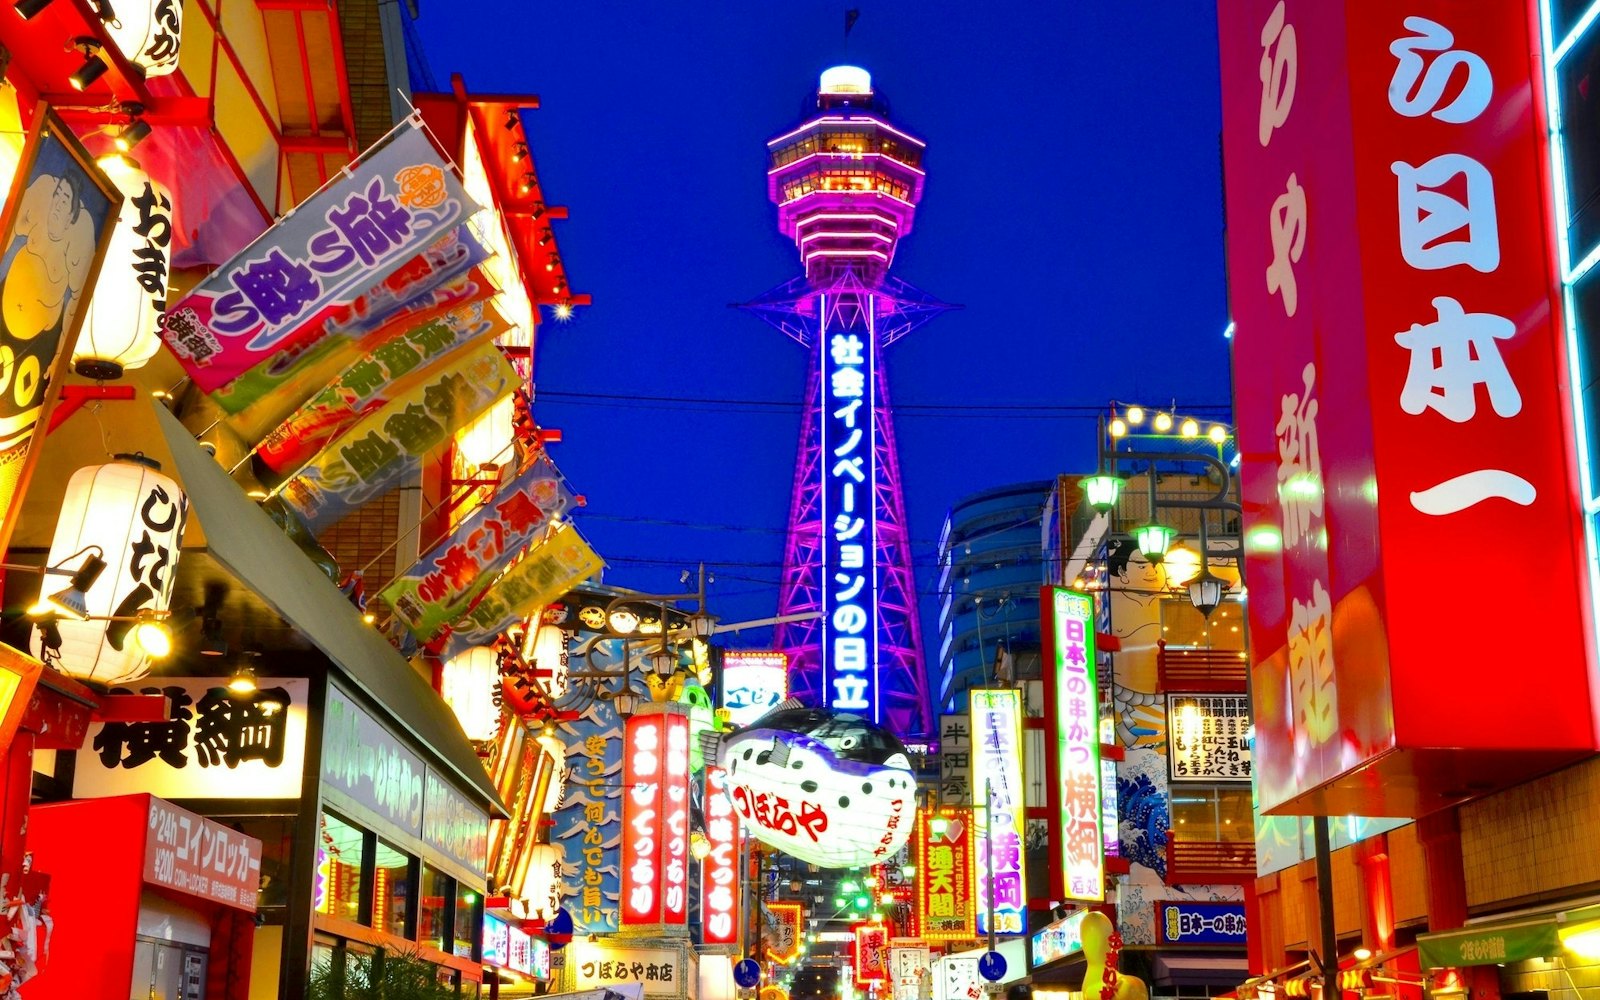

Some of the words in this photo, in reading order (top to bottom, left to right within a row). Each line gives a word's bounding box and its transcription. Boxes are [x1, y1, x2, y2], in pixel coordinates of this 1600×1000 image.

[210, 177, 414, 334] 造り盛り
[831, 334, 869, 710] 社会イノベーションの日立
[1065, 619, 1089, 764] 日本一の串かつ
[1175, 736, 1188, 775] もち
[1202, 736, 1214, 775] 紅しょうが
[1214, 736, 1226, 775] にんにく
[1227, 736, 1239, 775] 玉ねぎ
[157, 808, 177, 847] 24h
[1064, 769, 1098, 868] 横綱
[176, 815, 260, 883] コインロッカー
[955, 845, 966, 917] TSUTENKAKU
[582, 960, 673, 981] づぼらや本店
